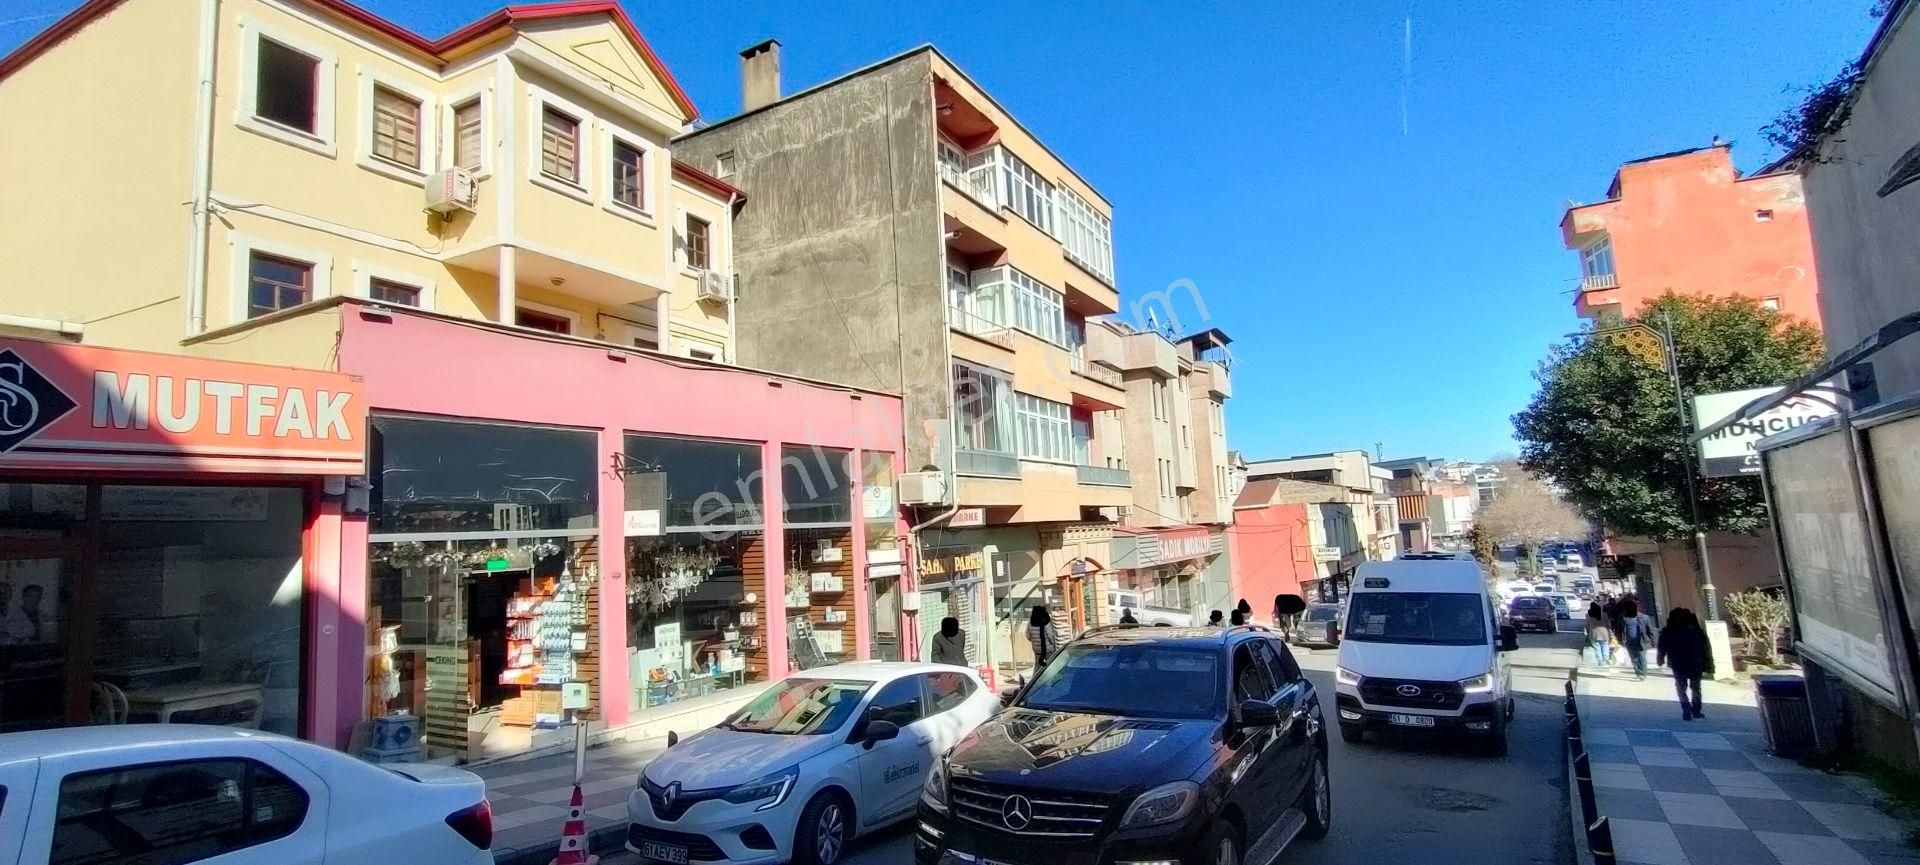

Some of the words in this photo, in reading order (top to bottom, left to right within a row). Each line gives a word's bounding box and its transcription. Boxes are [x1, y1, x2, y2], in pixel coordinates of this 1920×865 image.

[92, 370, 353, 441] MUTFAK
[1160, 538, 1182, 560] SADIK
[954, 553, 982, 571] PARKE
[653, 845, 670, 860] AEV
[671, 847, 688, 863] 399
